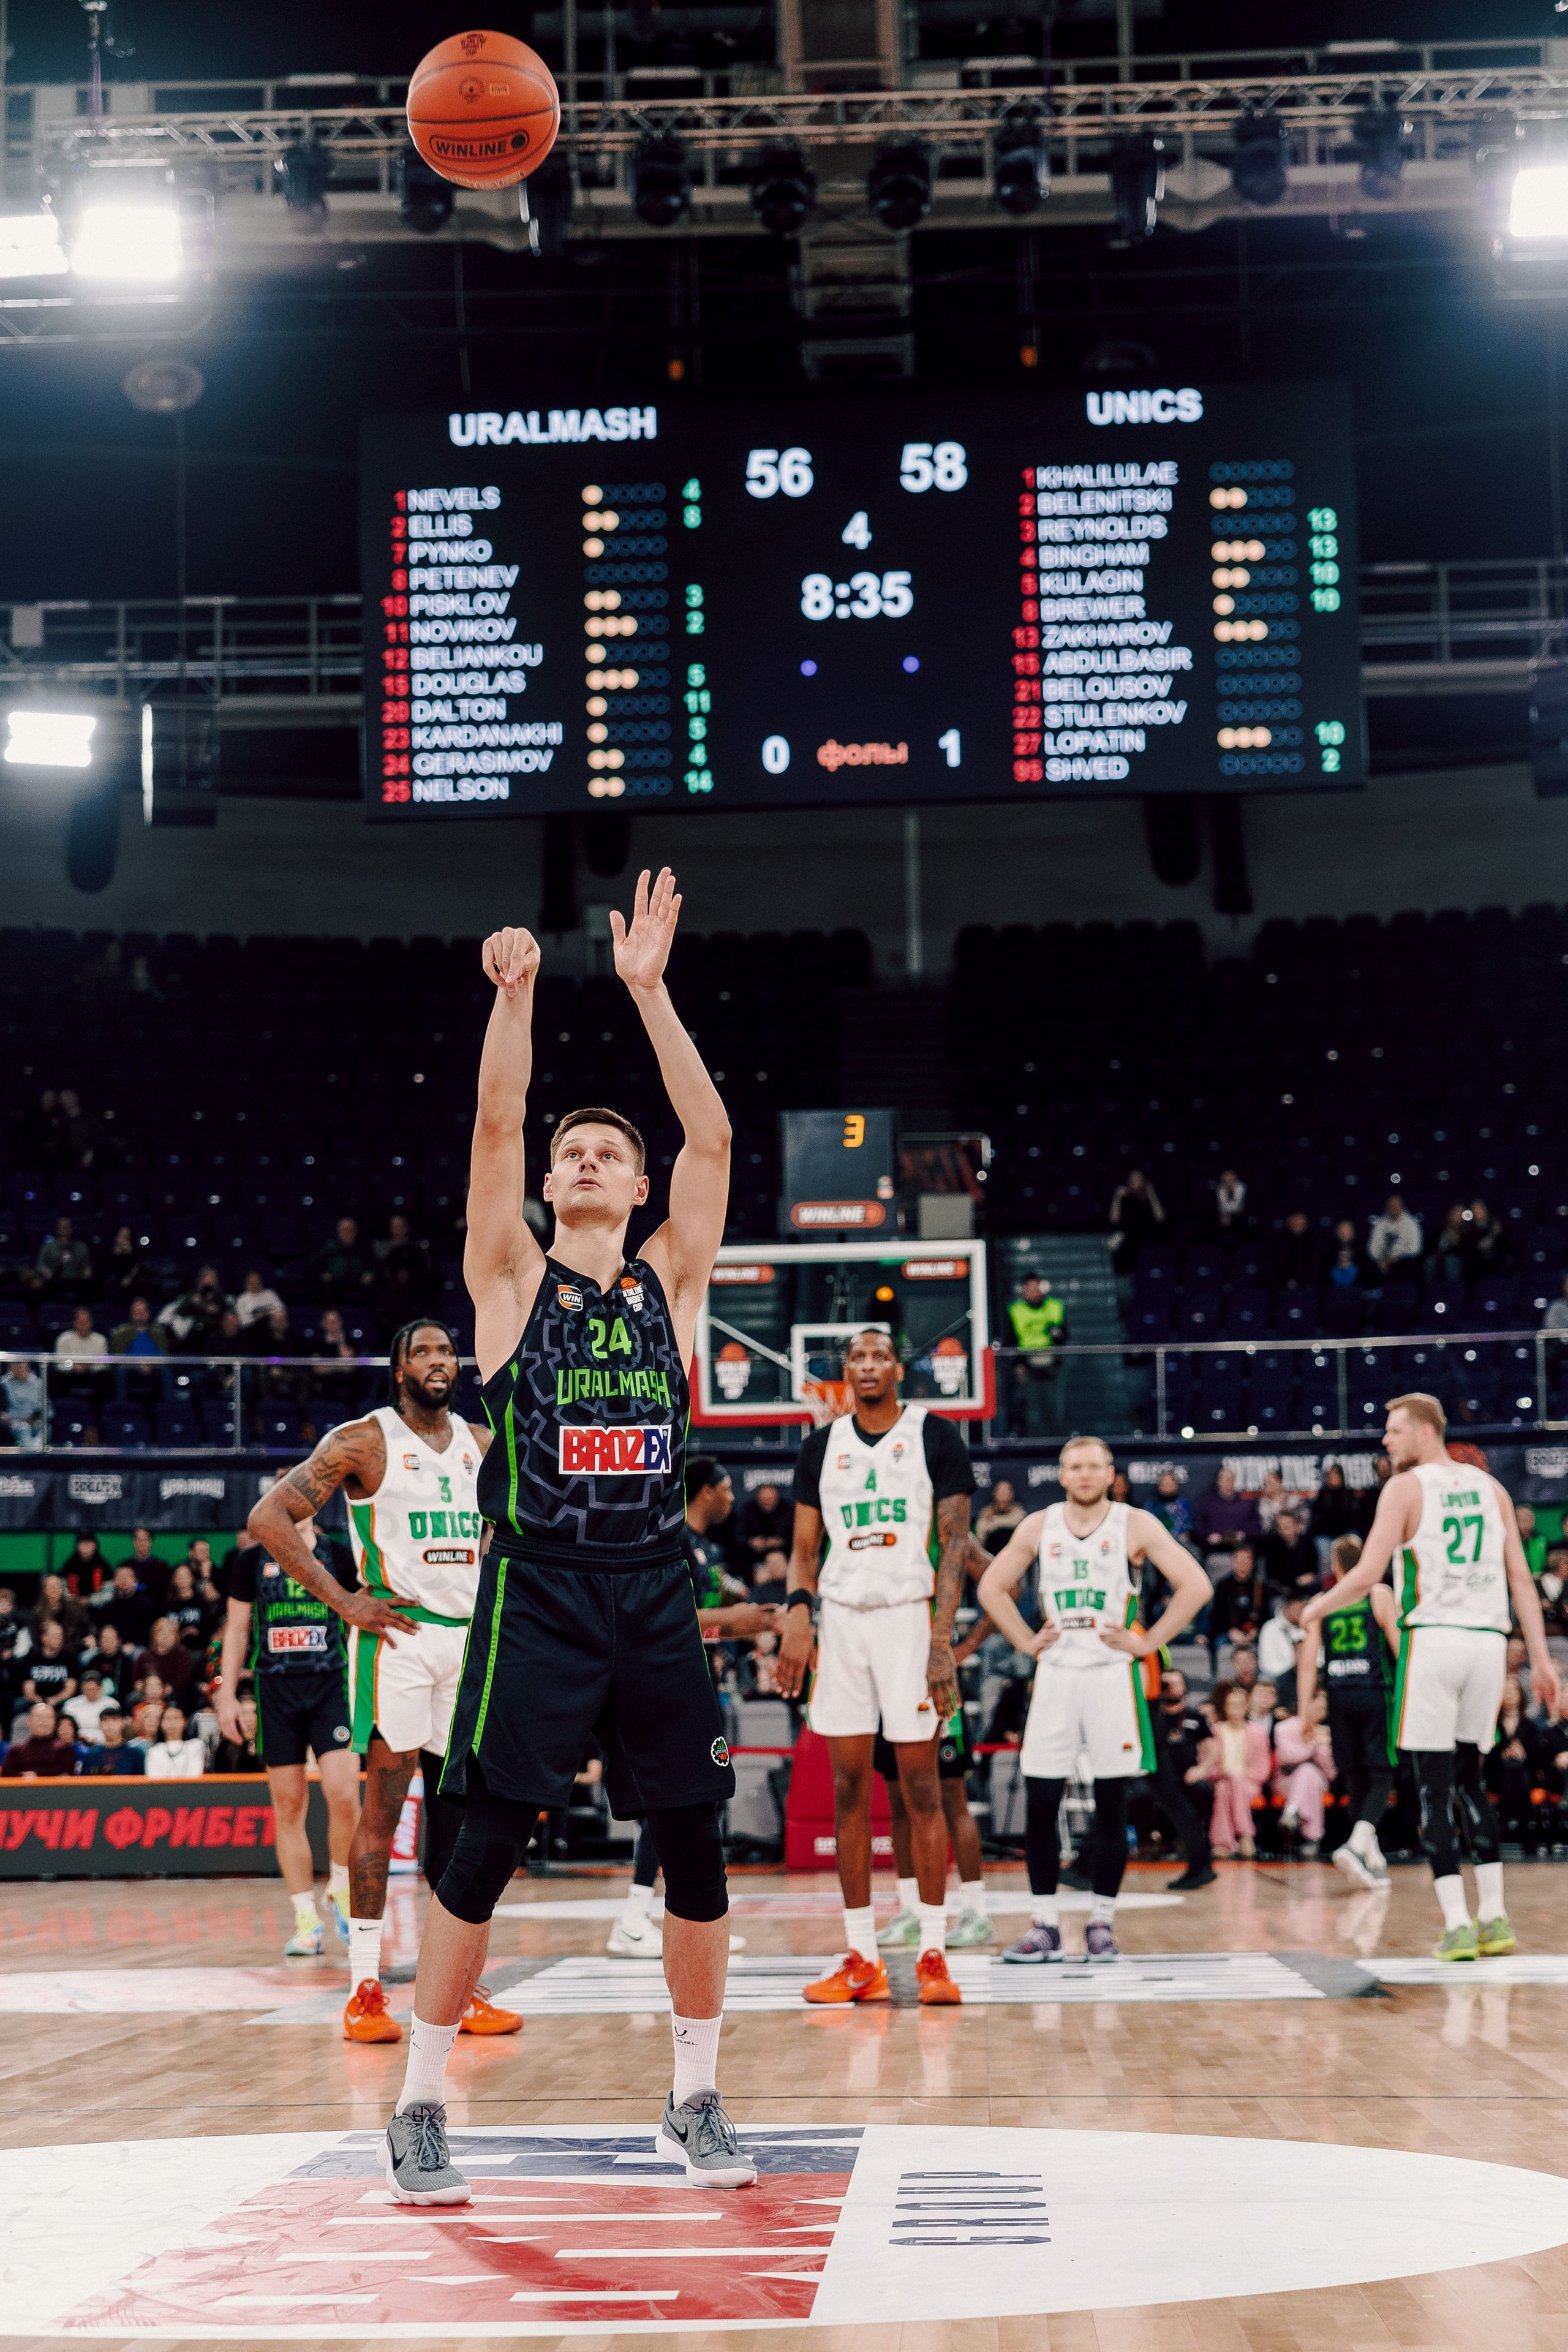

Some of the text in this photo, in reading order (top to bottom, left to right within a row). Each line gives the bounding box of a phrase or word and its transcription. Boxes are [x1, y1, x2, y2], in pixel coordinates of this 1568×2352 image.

[435, 139, 507, 157] WINLINE
[1087, 388, 1204, 426] UNICS
[449, 406, 657, 447] URALMASH
[745, 442, 968, 498] 56 58
[1022, 468, 1035, 488] 1
[394, 478, 701, 511] 1 NEVELS 4
[1019, 494, 1035, 516] 2
[408, 513, 473, 538] ELLIS
[842, 511, 872, 549] 4
[1020, 508, 1338, 542] 3 REYNOLDS 13
[392, 539, 492, 565] 7 PYNKO
[1020, 547, 1036, 568] 4
[1308, 534, 1338, 559] 13
[409, 565, 519, 590] PETENEV
[1039, 569, 1144, 595] KULAGIN
[409, 592, 510, 617] PISKLOV
[686, 584, 704, 608] 3
[801, 571, 913, 620] 8:35
[1040, 595, 1146, 622] BREWER
[385, 611, 704, 644] 11 NOVIKOV 2
[1041, 620, 1173, 649] ZAKHAROV
[382, 643, 543, 670] 12 BELIANKOU
[412, 670, 526, 696] DOUGLAS
[687, 664, 706, 687] 5
[1015, 674, 1173, 702] 21 BELOUSOV
[411, 698, 507, 723] DALTON
[684, 690, 710, 713] 11
[1044, 700, 1188, 728] STULENKOV
[689, 717, 707, 740] 5
[1044, 728, 1145, 755] LOPATIN
[412, 749, 554, 776] GERASIMOV
[688, 743, 707, 766] 4
[762, 729, 960, 774] 0 фолы 1
[1046, 755, 1129, 782] SHVED
[1322, 748, 1340, 772] 2
[412, 777, 509, 802] NELSON
[842, 1115, 865, 1148] 3
[562, 1293, 581, 1303] WIN
[625, 1292, 644, 1305] BASKET
[632, 1302, 644, 1313] CUP
[589, 1317, 632, 1359] 24
[557, 1369, 671, 1408] URALMASH
[562, 1428, 671, 1472] BROZEX
[438, 1476, 453, 1503] 3
[865, 1468, 876, 1492] 4
[409, 1511, 480, 1539] UNICS
[1443, 1514, 1483, 1564] 27
[427, 1551, 468, 1562] WINLINE
[1329, 1616, 1368, 1652] 23
[103, 1806, 276, 1850] ФРИБЕТ
